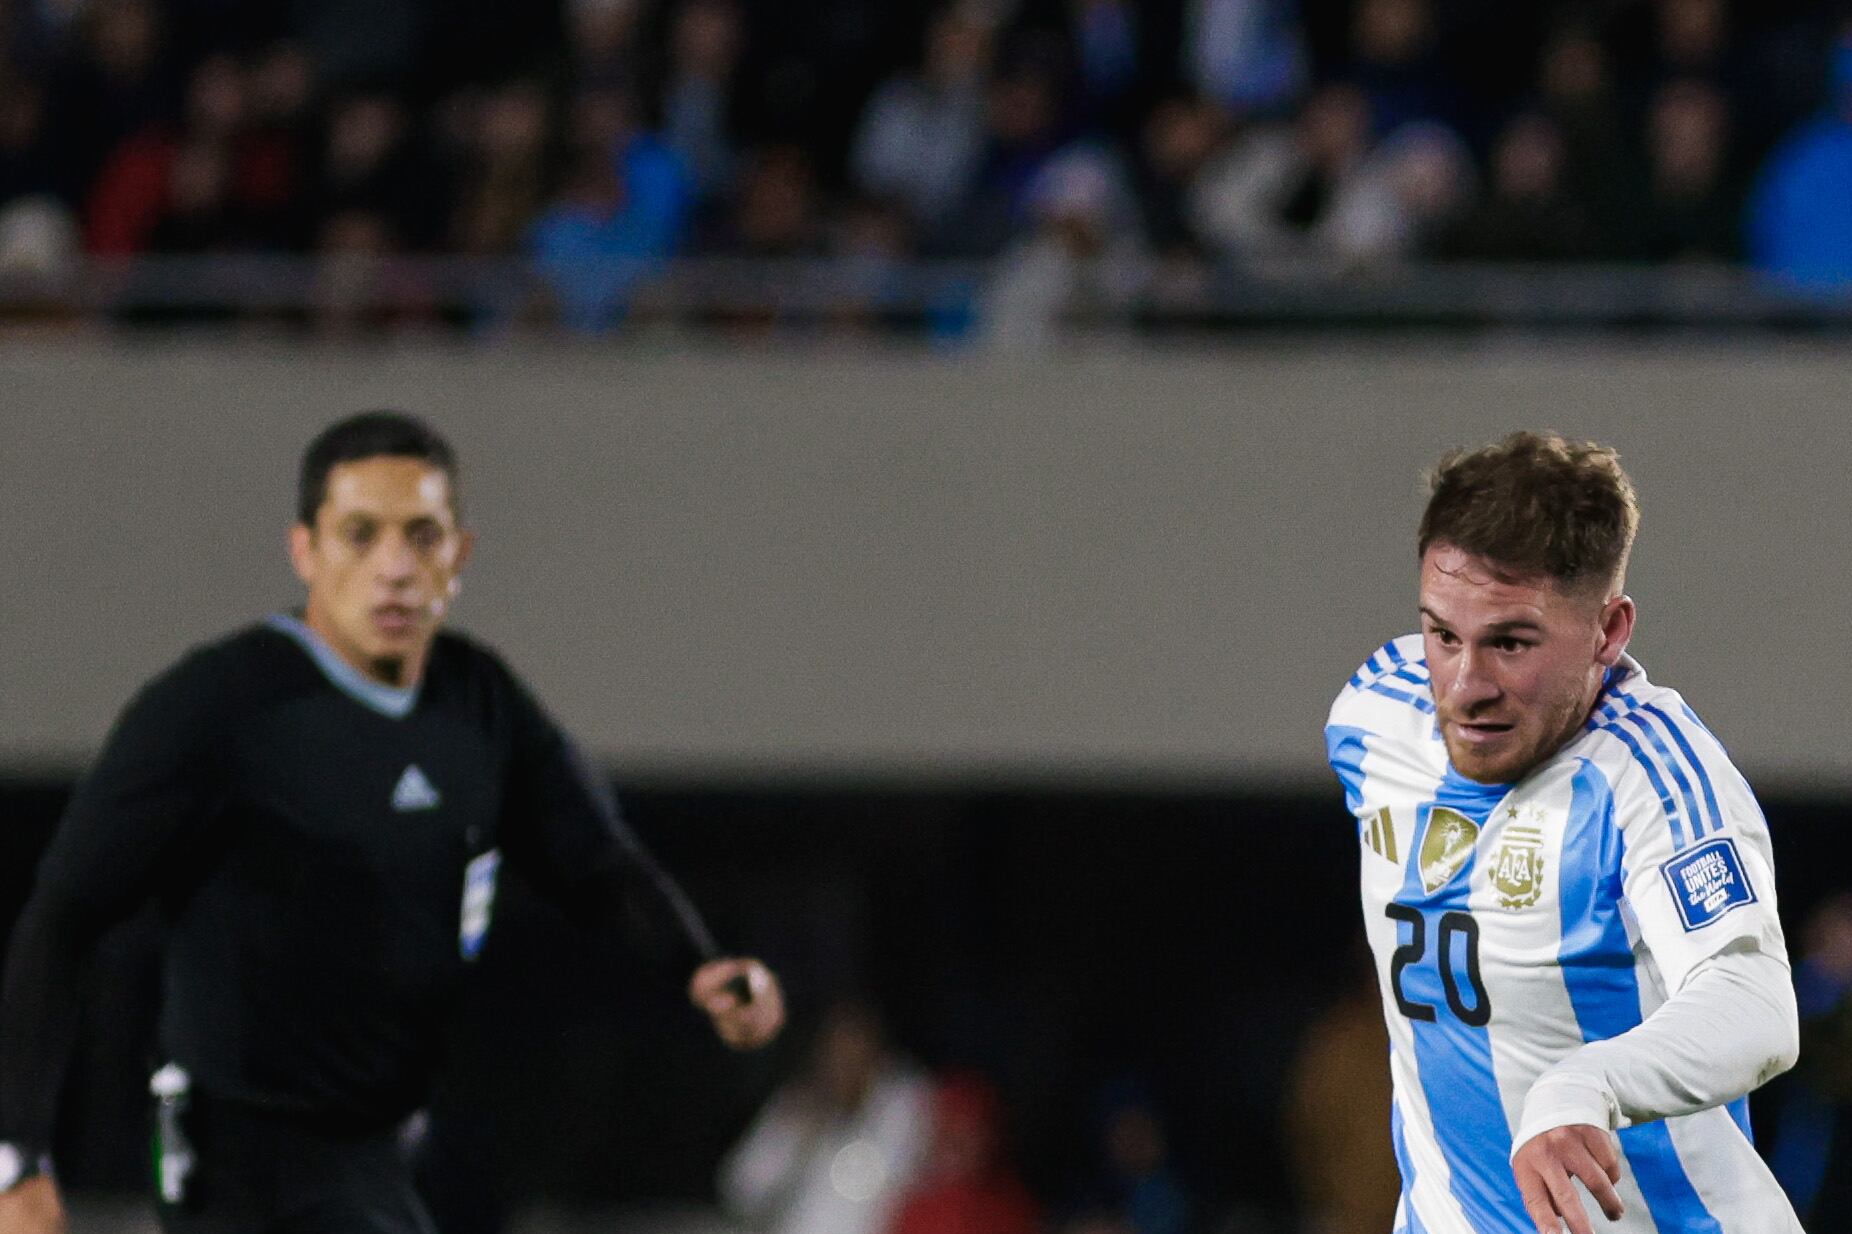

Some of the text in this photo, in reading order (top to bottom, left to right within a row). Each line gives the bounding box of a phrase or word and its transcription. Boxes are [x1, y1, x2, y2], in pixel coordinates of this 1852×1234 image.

[1498, 847, 1532, 887] AFA
[1680, 851, 1724, 880] FOOTBALL
[1684, 859, 1728, 894] UNITES
[1385, 902, 1491, 1027] 20
